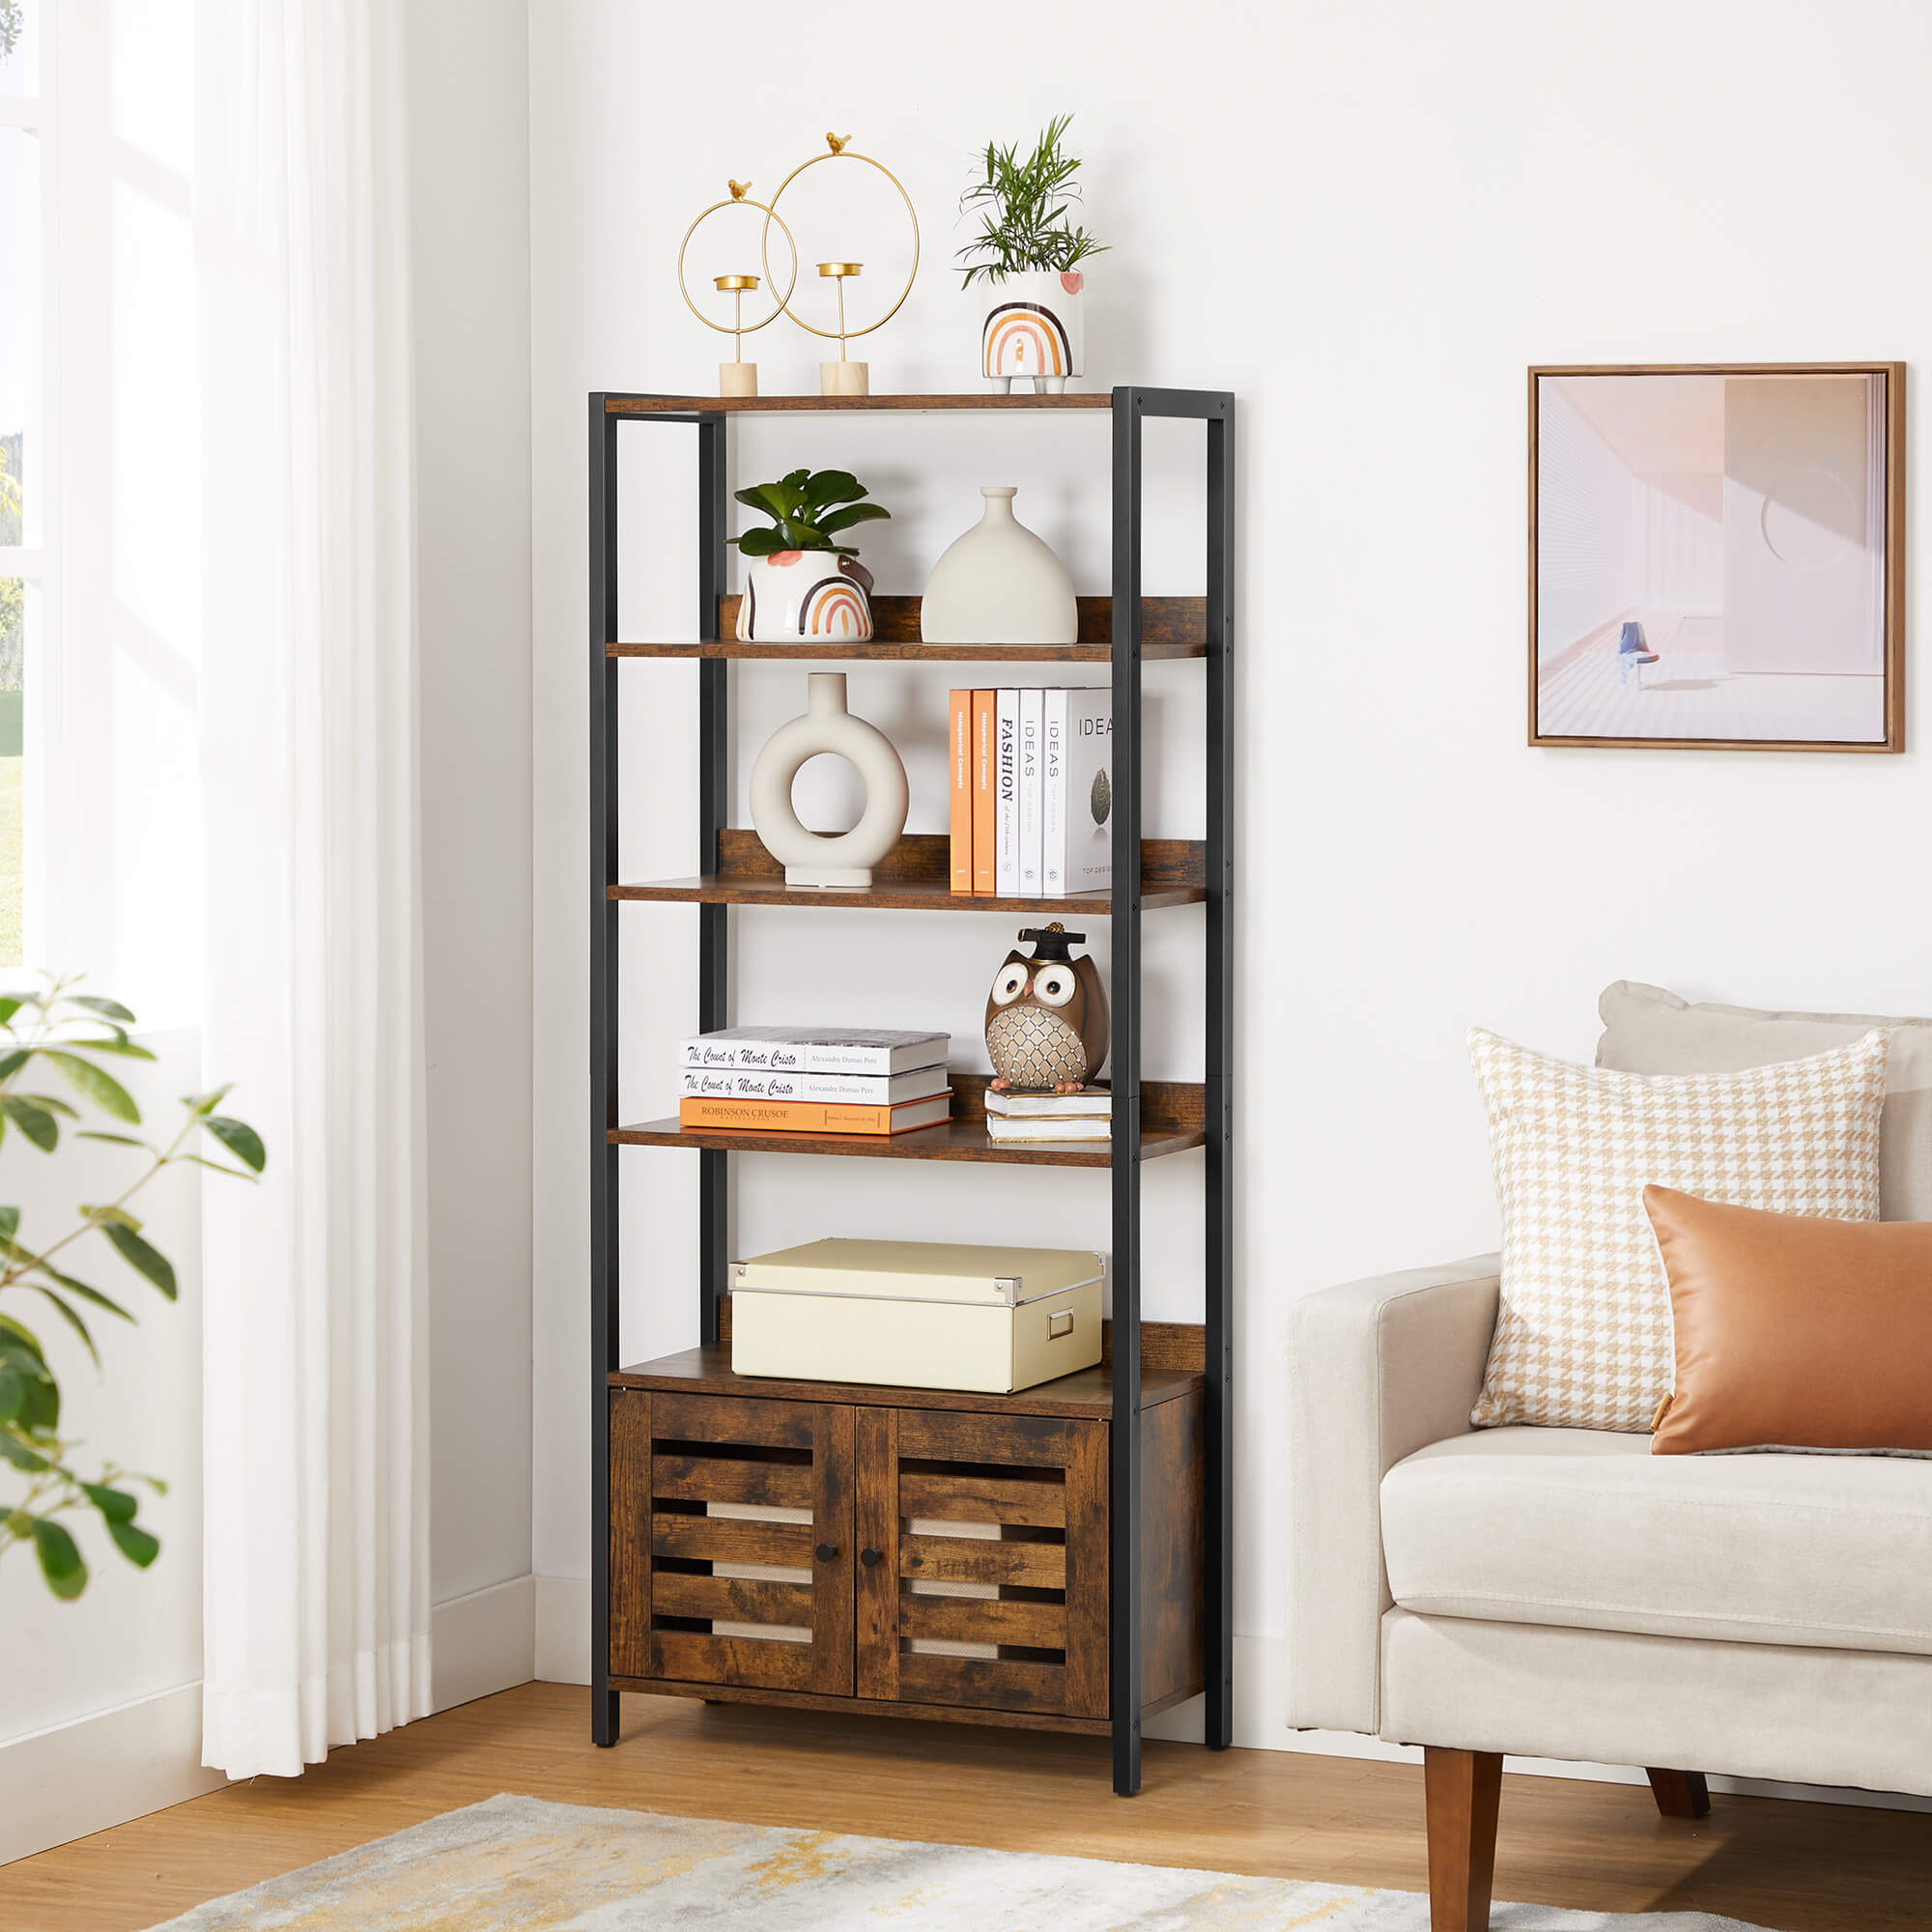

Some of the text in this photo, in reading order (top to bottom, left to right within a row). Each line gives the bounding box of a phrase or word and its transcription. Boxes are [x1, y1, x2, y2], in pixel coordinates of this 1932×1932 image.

[1002, 718, 1013, 802] FASHION
[1025, 720, 1035, 777] IDEAS
[1049, 721, 1059, 778] IDEAS
[687, 1045, 797, 1067] The Count of Monte Cristo
[684, 1074, 794, 1096] The Count of Monte Cristo
[701, 1106, 752, 1117] ROBINSON
[752, 1108, 789, 1119] CRUSOE
